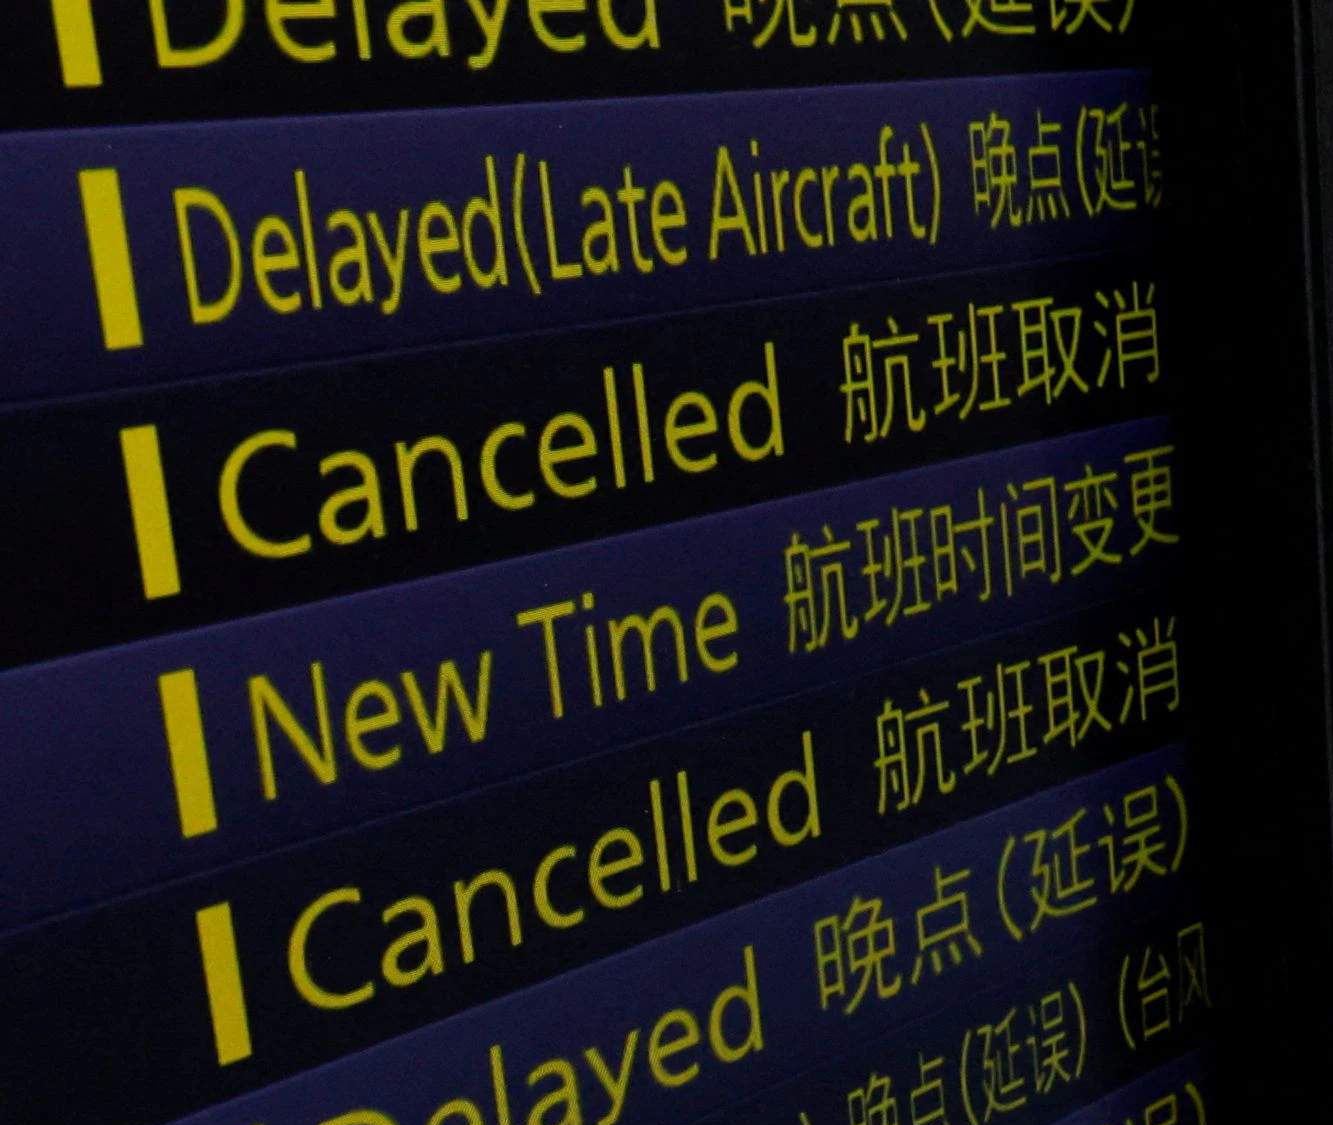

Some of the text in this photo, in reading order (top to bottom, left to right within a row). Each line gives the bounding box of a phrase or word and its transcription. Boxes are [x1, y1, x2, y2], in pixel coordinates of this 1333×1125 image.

[170, 151, 690, 326] Delayed(Late
[707, 121, 943, 262] Aircraft)
[217, 279, 1161, 559] Cancelled 航班取消
[245, 443, 1182, 802] New Time 航班时间变更
[286, 615, 1181, 1011] Cancelled 航班取消
